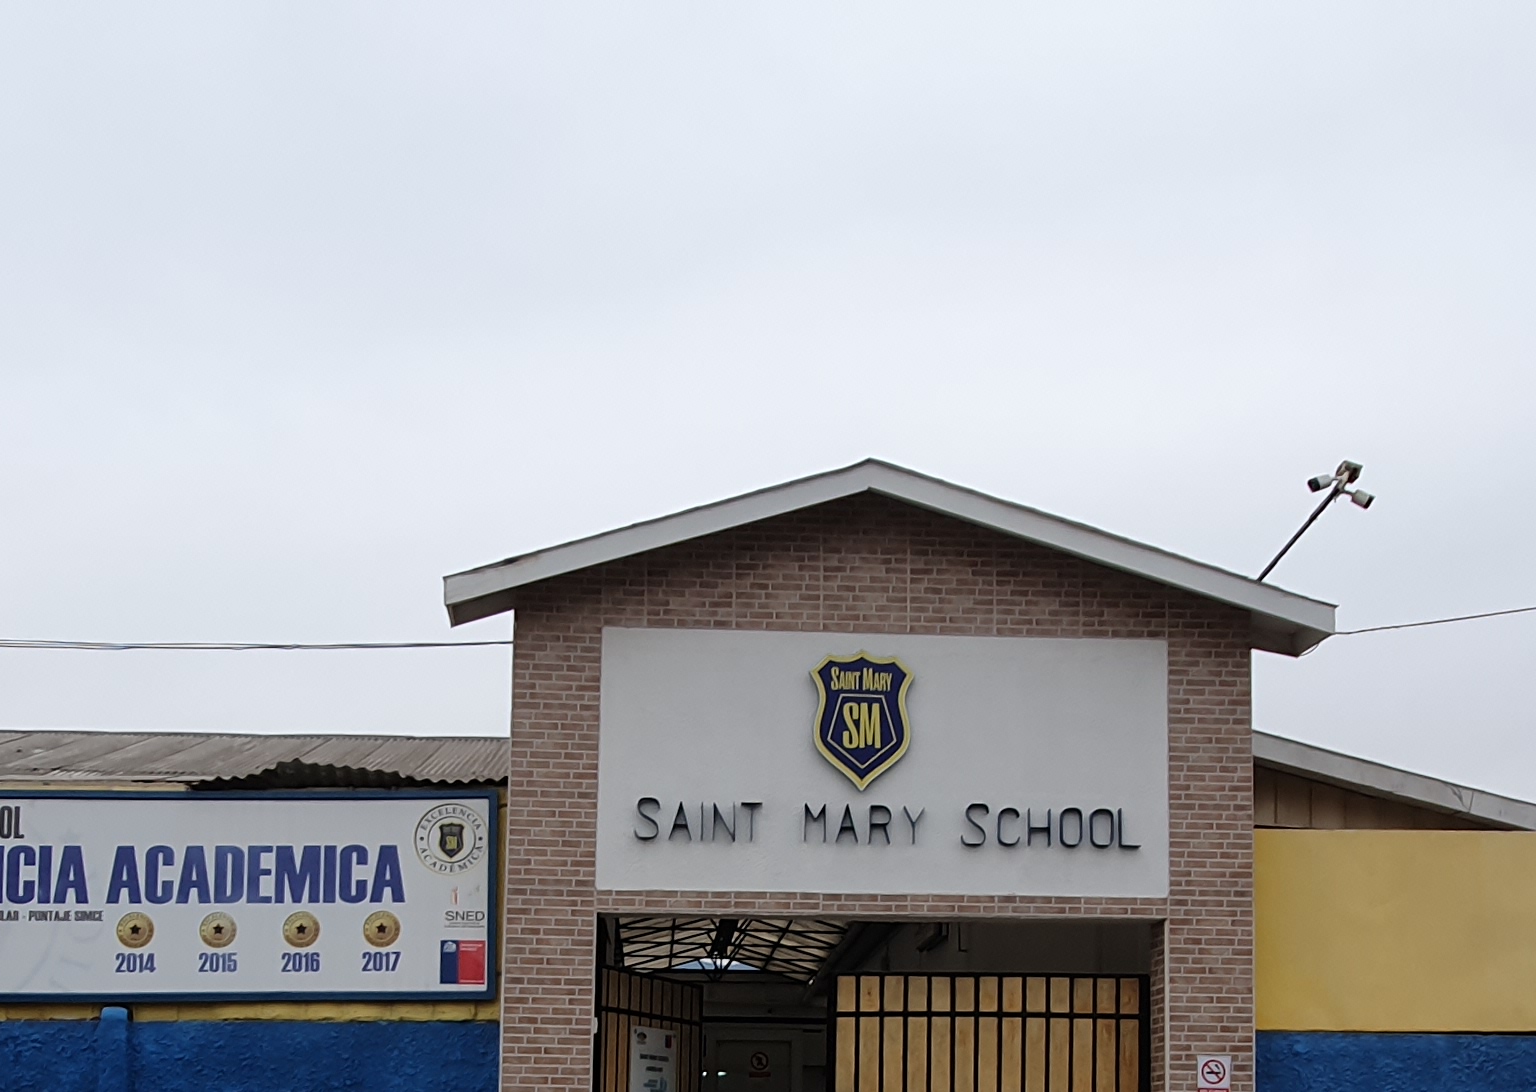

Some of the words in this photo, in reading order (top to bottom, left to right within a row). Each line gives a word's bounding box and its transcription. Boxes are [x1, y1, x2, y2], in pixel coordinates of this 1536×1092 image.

[831, 666, 861, 690] SAINT
[862, 667, 893, 692] MARY
[843, 702, 881, 749] SM
[420, 806, 482, 831] EXCELENCIA
[634, 797, 763, 843] SAINT
[803, 802, 926, 845] MARY
[960, 803, 1141, 849] SCHOOL
[105, 844, 406, 905] ACADEMICA
[444, 910, 485, 921] SNED
[115, 953, 156, 973] 2014
[198, 953, 238, 973] 2015
[281, 952, 321, 973] 2016
[362, 951, 402, 972] 2017
